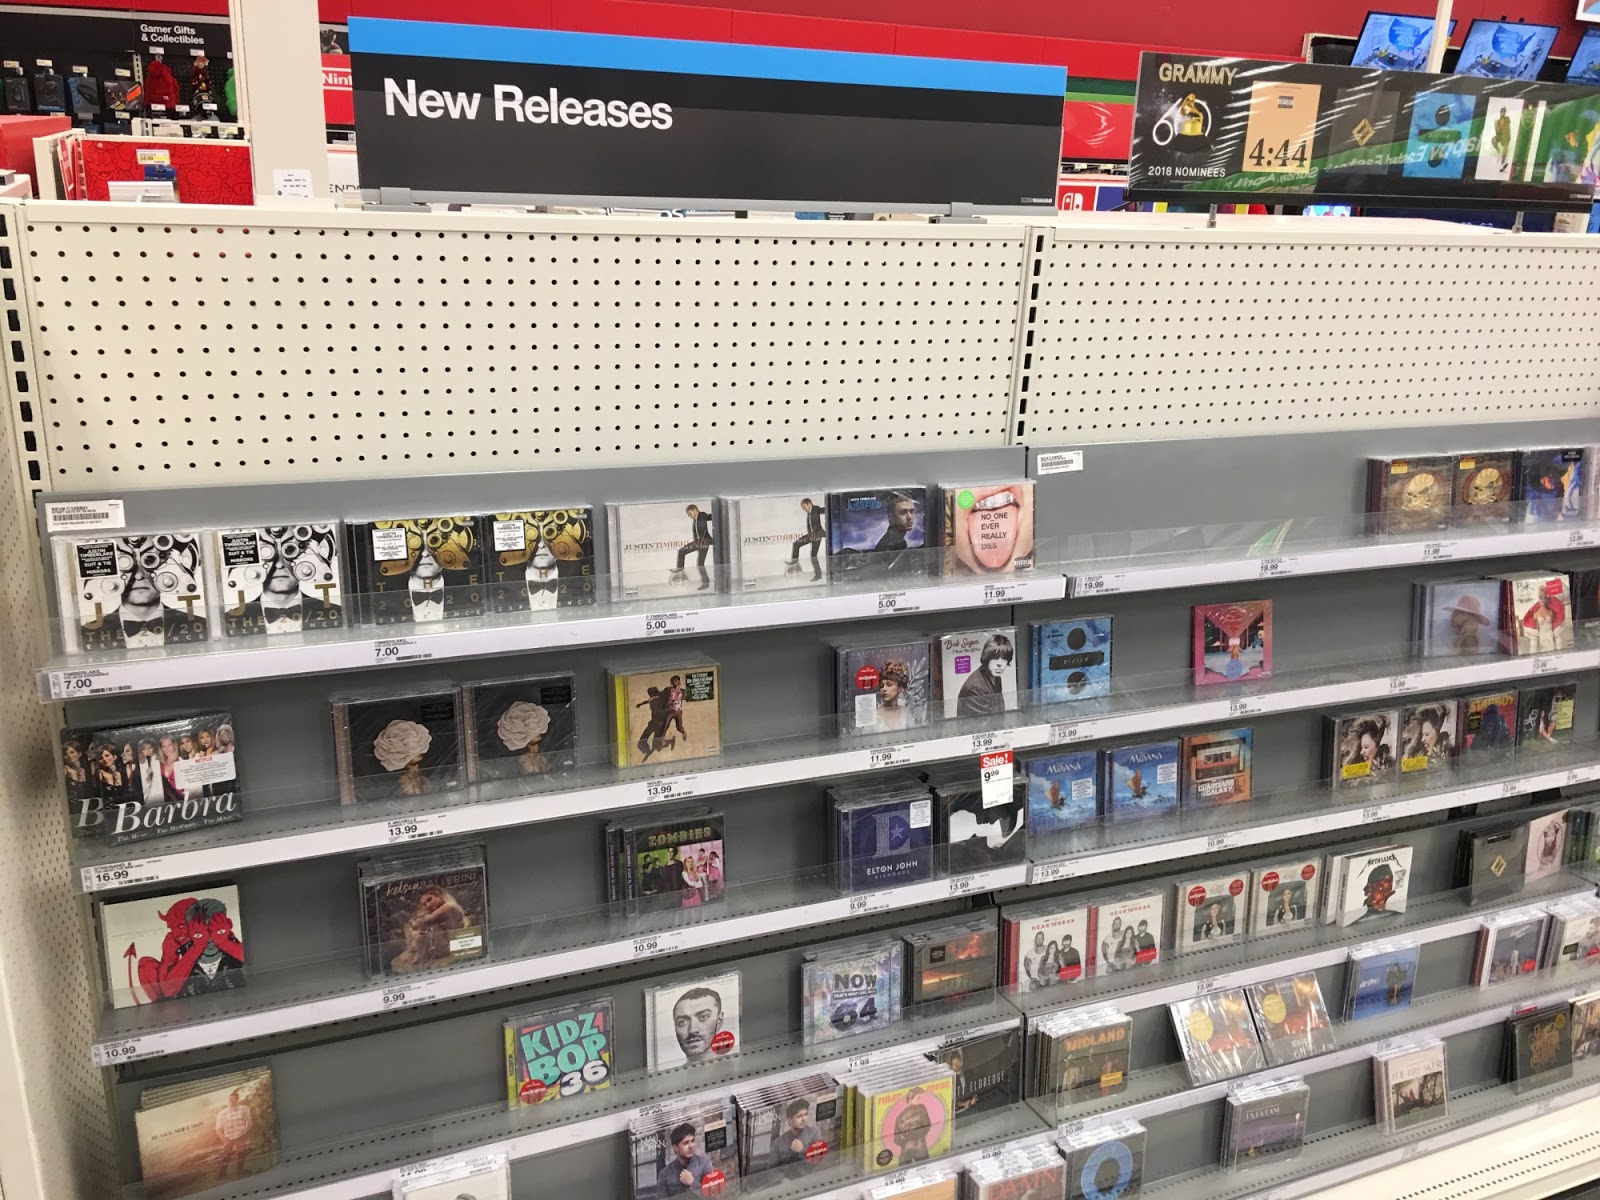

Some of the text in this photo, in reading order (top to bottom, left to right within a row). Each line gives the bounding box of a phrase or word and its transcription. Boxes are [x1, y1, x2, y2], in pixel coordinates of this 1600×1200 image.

[140, 23, 196, 35] Gamer Gifts
[141, 33, 204, 45] & Collectibles
[1158, 62, 1237, 86] GRAMMY
[384, 77, 673, 131] New Releases
[1248, 137, 1308, 168] 4:44
[1147, 165, 1226, 178] 2018 NOMINEES
[981, 523, 1000, 531] EVER
[981, 532, 1007, 540] REALLY
[981, 542, 998, 550] DIES
[1260, 563, 1279, 572] 19.99
[1084, 581, 1104, 590] 19.99
[984, 589, 1005, 599] 11.99
[878, 599, 896, 609] 5.00
[646, 620, 667, 630] 5.00
[944, 638, 959, 650] Bob
[374, 646, 399, 657] 7.00
[63, 678, 92, 690] 7.00
[1229, 703, 1247, 712] 13.99
[1057, 729, 1078, 739] 13.99
[972, 739, 993, 748] 13.99
[870, 752, 892, 763] 11.99
[982, 753, 1008, 769] Sale!
[647, 785, 672, 796] 13.99
[111, 790, 237, 836] Barbra
[388, 824, 418, 837] 13.99
[648, 826, 712, 848] ZOMBIES
[866, 859, 918, 876] ELTON JOHN
[1357, 853, 1403, 879] METALLICA
[95, 870, 129, 883] 16.99
[874, 869, 910, 880] DIAMONDS
[1040, 868, 1060, 878] 13.99
[420, 872, 476, 889] BALLERINI
[949, 881, 969, 891] 13.99
[849, 900, 867, 910] 9.99
[633, 941, 658, 953] 10.99
[834, 973, 877, 989] NOW
[1196, 982, 1213, 991] 13.99
[383, 992, 405, 1004] 9.99
[829, 996, 878, 1032] 64
[519, 1011, 599, 1062] KIDZ
[1064, 1026, 1126, 1052] MIDLAND
[711, 1039, 735, 1048] exclusive
[104, 1046, 136, 1059] 10.99
[527, 1033, 607, 1087] BOP
[560, 1060, 608, 1097] 36
[521, 1087, 547, 1096] exclusive
[969, 1080, 1005, 1103] ELDREDGE
[702, 1177, 725, 1189] exclusive
